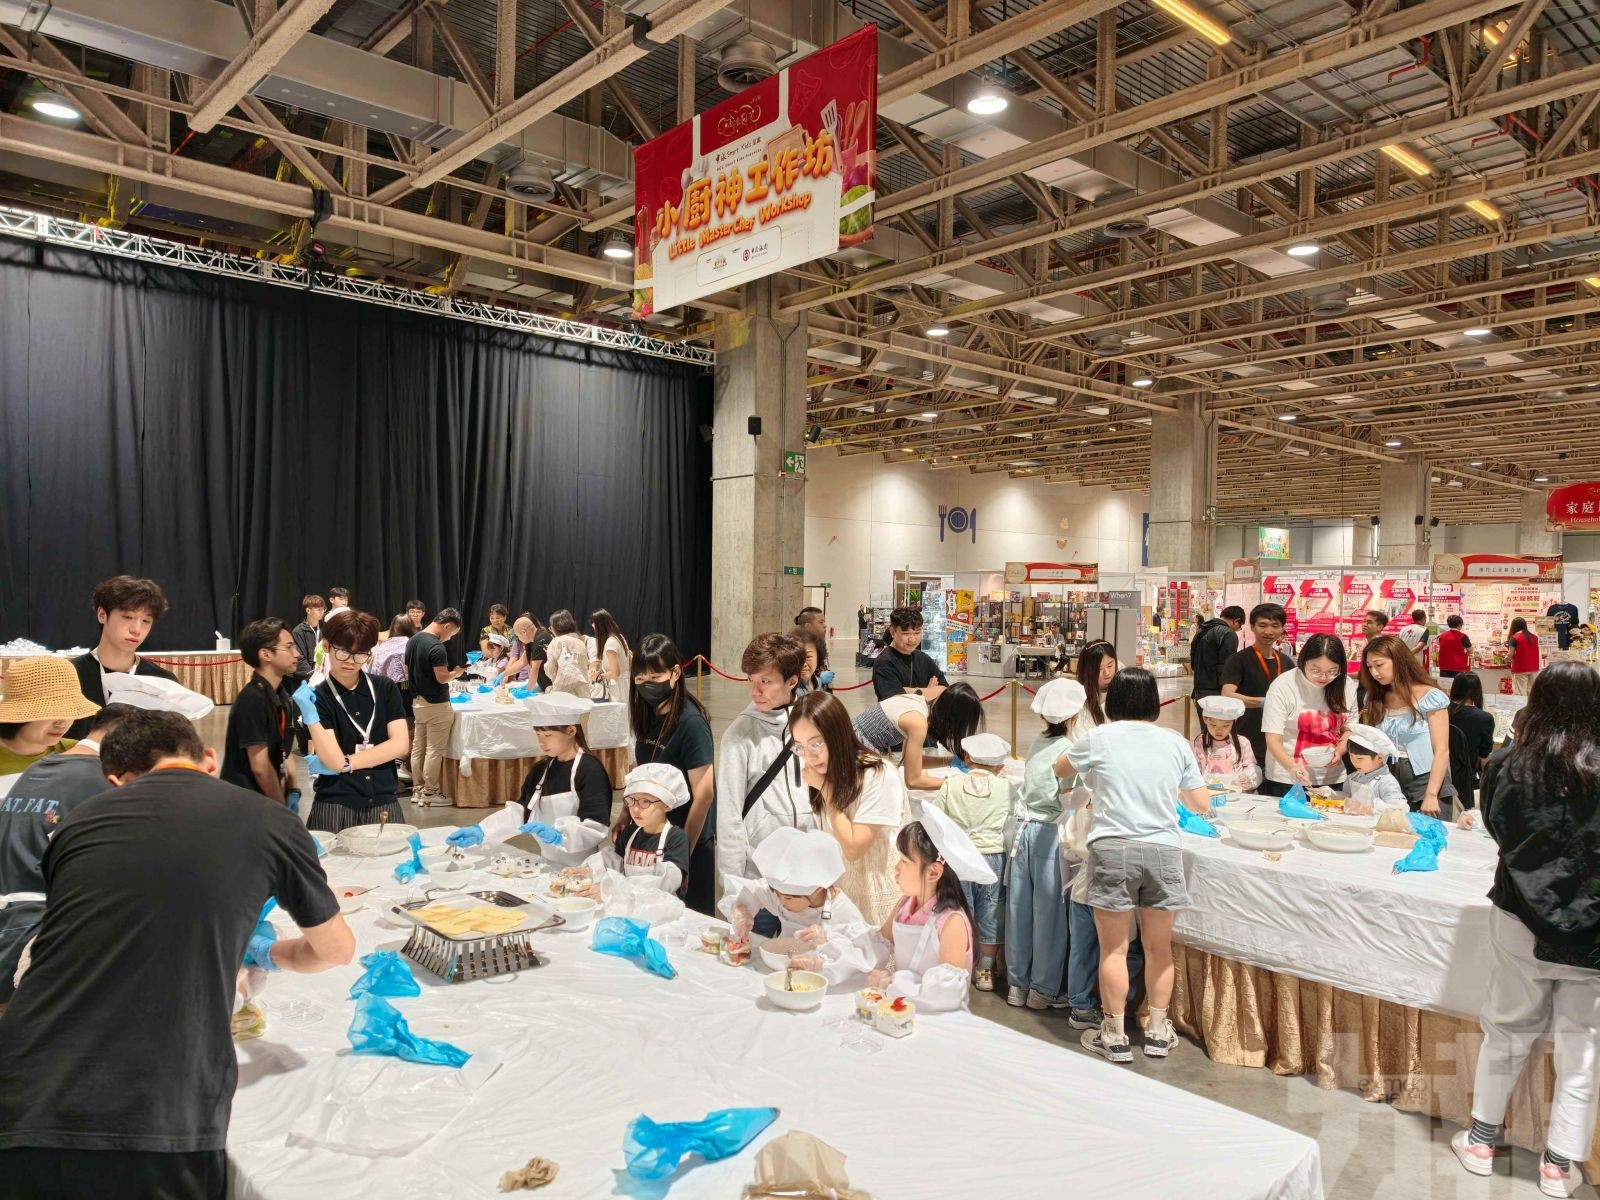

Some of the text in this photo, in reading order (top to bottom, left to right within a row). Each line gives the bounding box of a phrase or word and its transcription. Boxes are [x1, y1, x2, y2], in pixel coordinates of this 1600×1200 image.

[668, 238, 696, 260] Little
[759, 191, 812, 224] Workshop
[1566, 500, 1600, 515] 家庭
